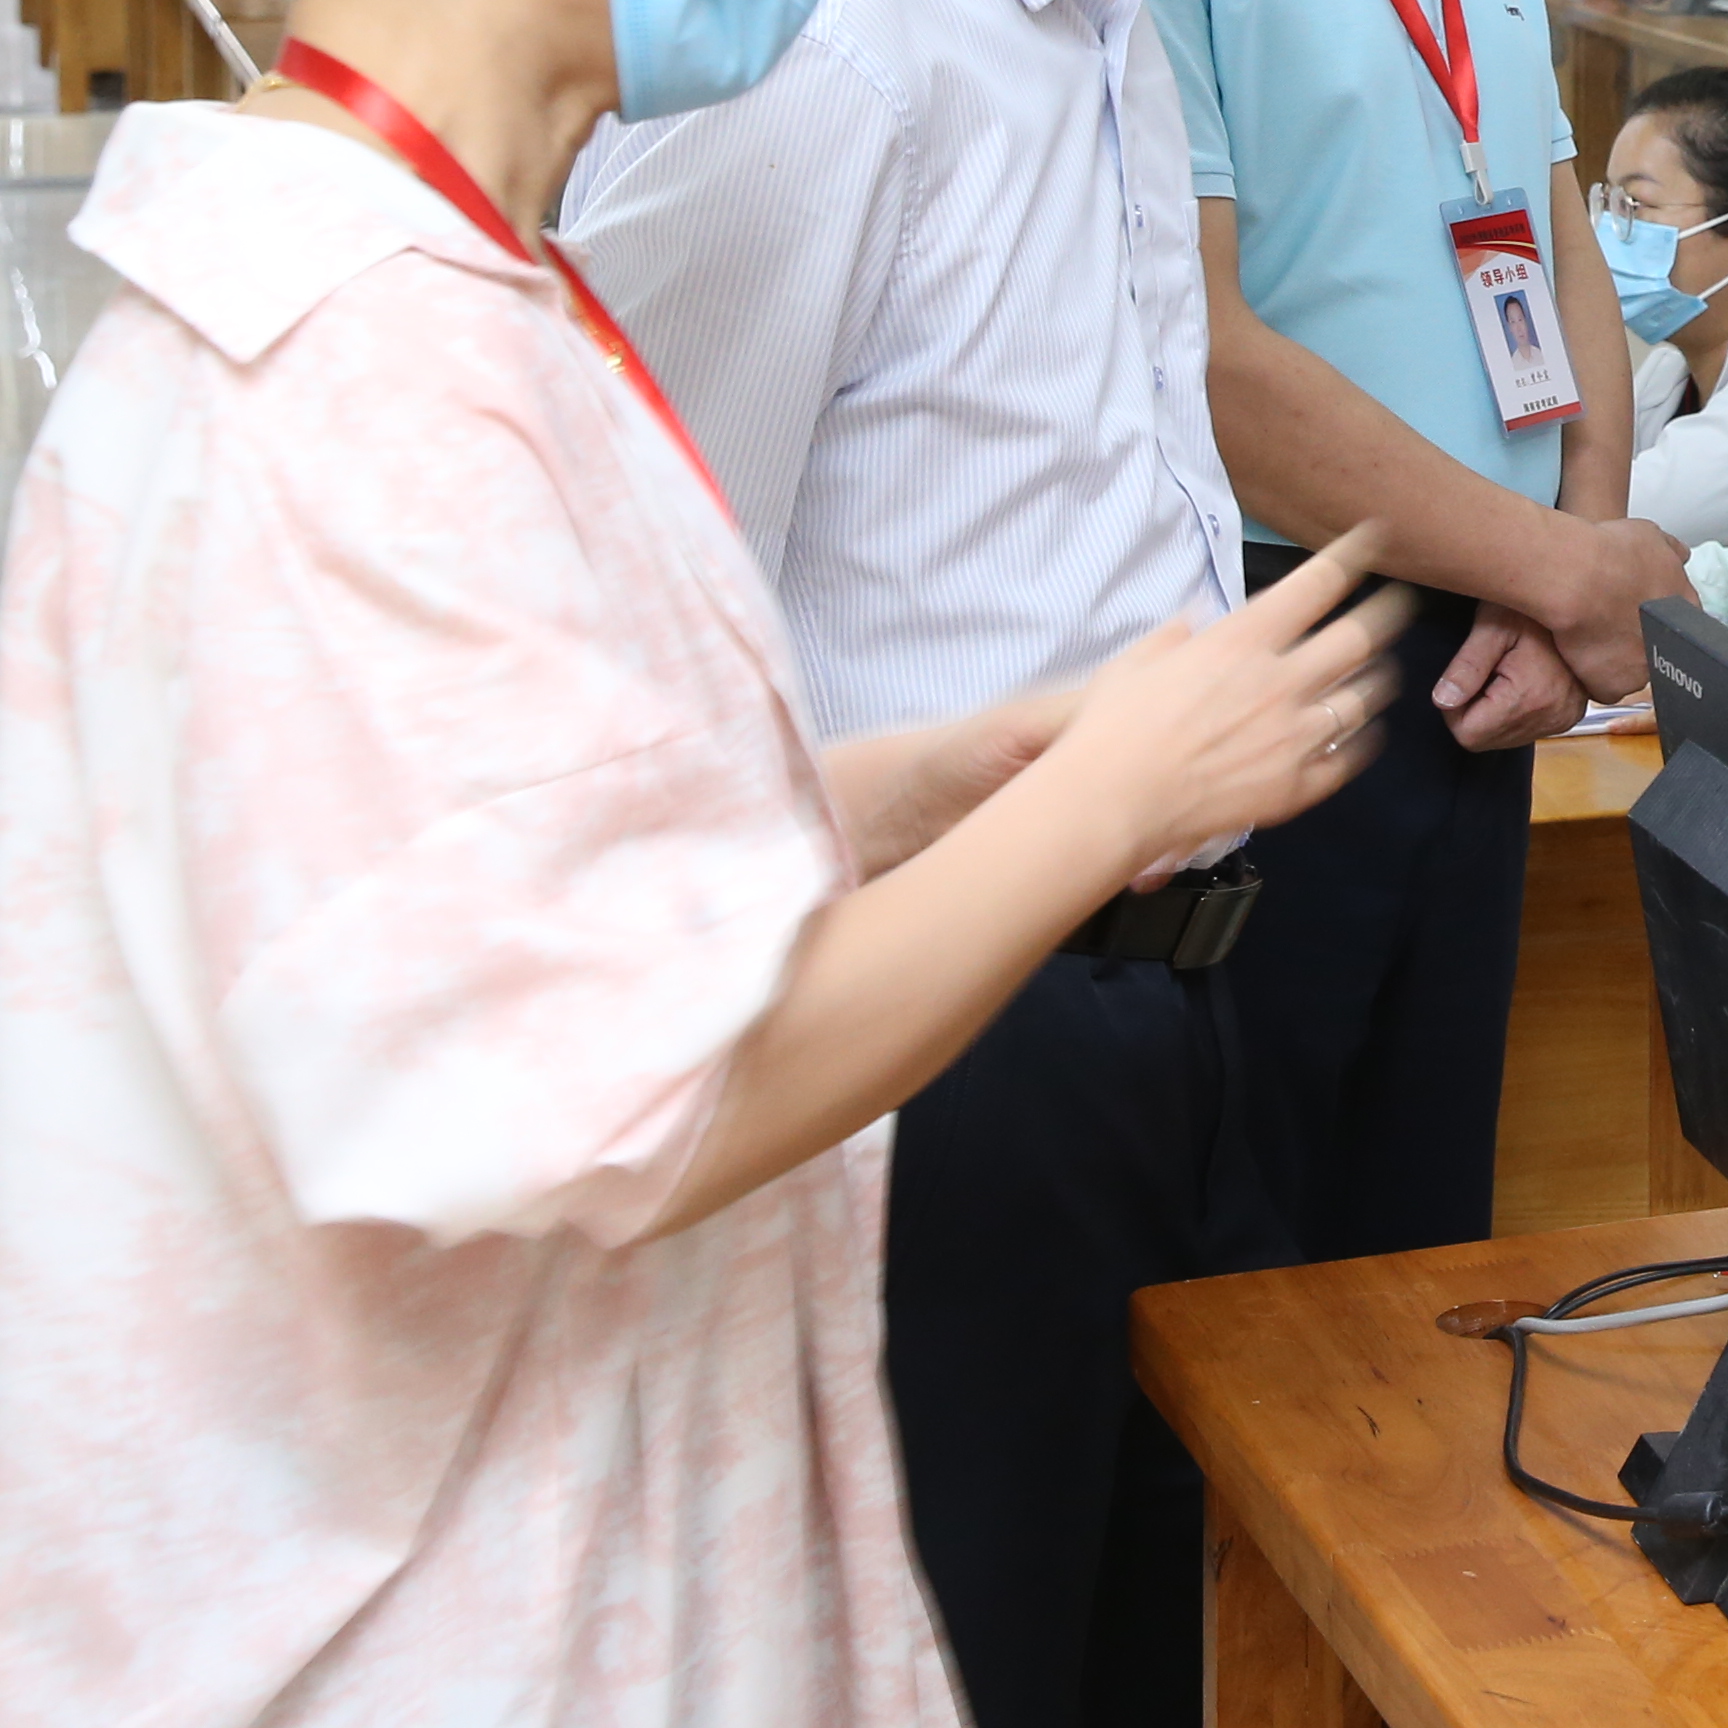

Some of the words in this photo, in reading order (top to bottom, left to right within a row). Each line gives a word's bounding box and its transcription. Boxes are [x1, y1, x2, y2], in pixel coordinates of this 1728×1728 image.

[1480, 264, 1528, 288] 领导小组
[1653, 644, 1703, 700] lenovo
